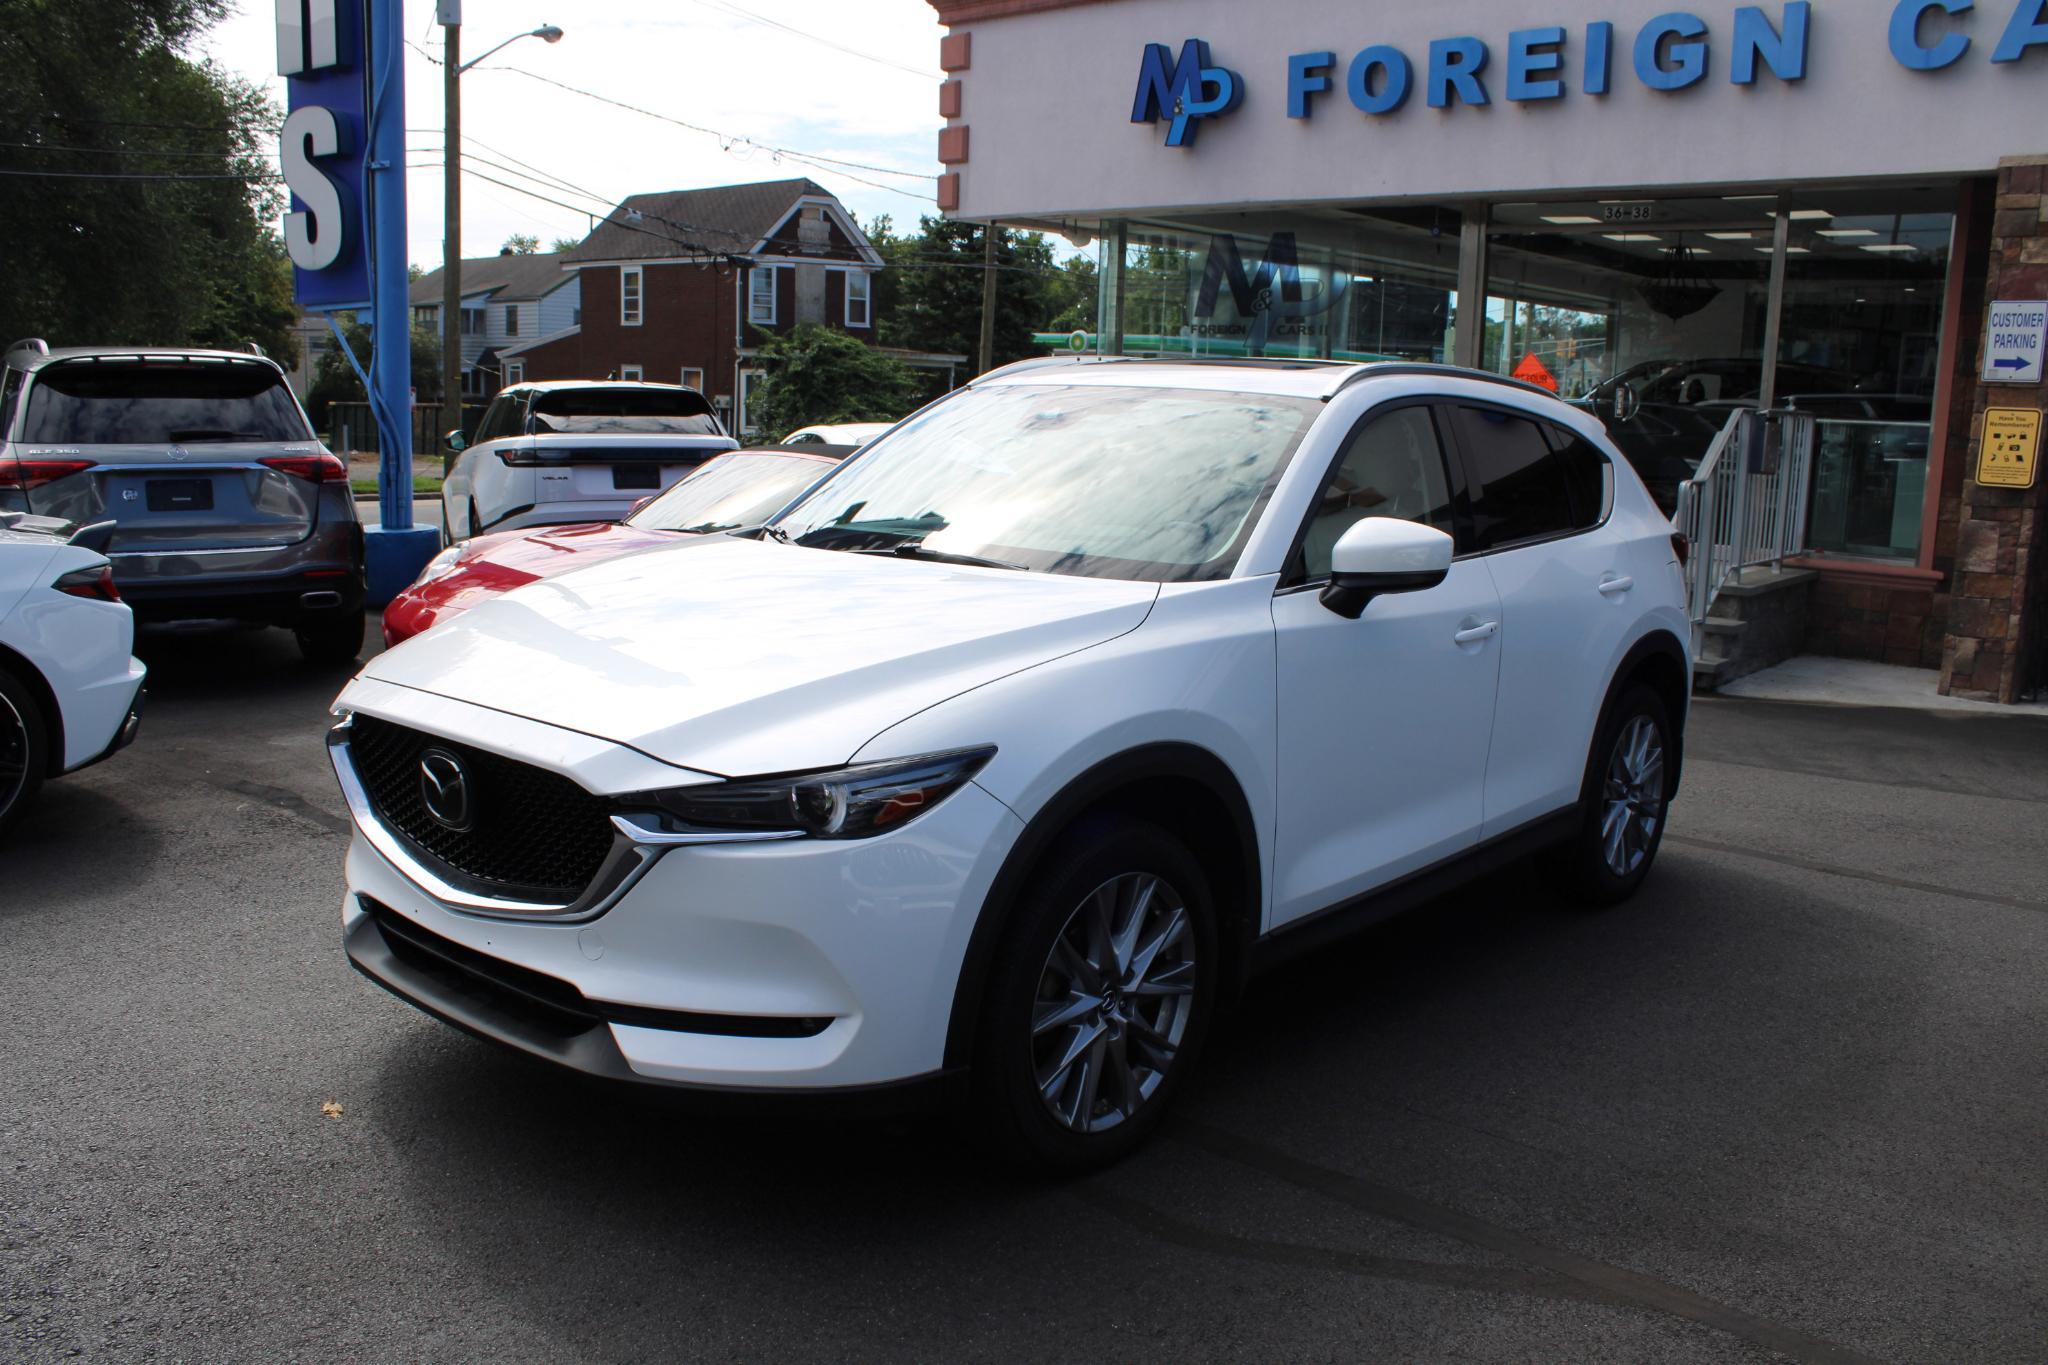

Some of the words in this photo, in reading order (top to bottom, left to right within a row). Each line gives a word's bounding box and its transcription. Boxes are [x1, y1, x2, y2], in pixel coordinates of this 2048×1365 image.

[1287, 0, 1811, 119] FOREIGN
[1606, 207, 1650, 218] 36-38
[1992, 312, 2044, 328] CUSTOMER
[1191, 325, 1246, 335] FOREIGN
[1276, 325, 1315, 336] CARS
[1994, 333, 2037, 349] PARKING
